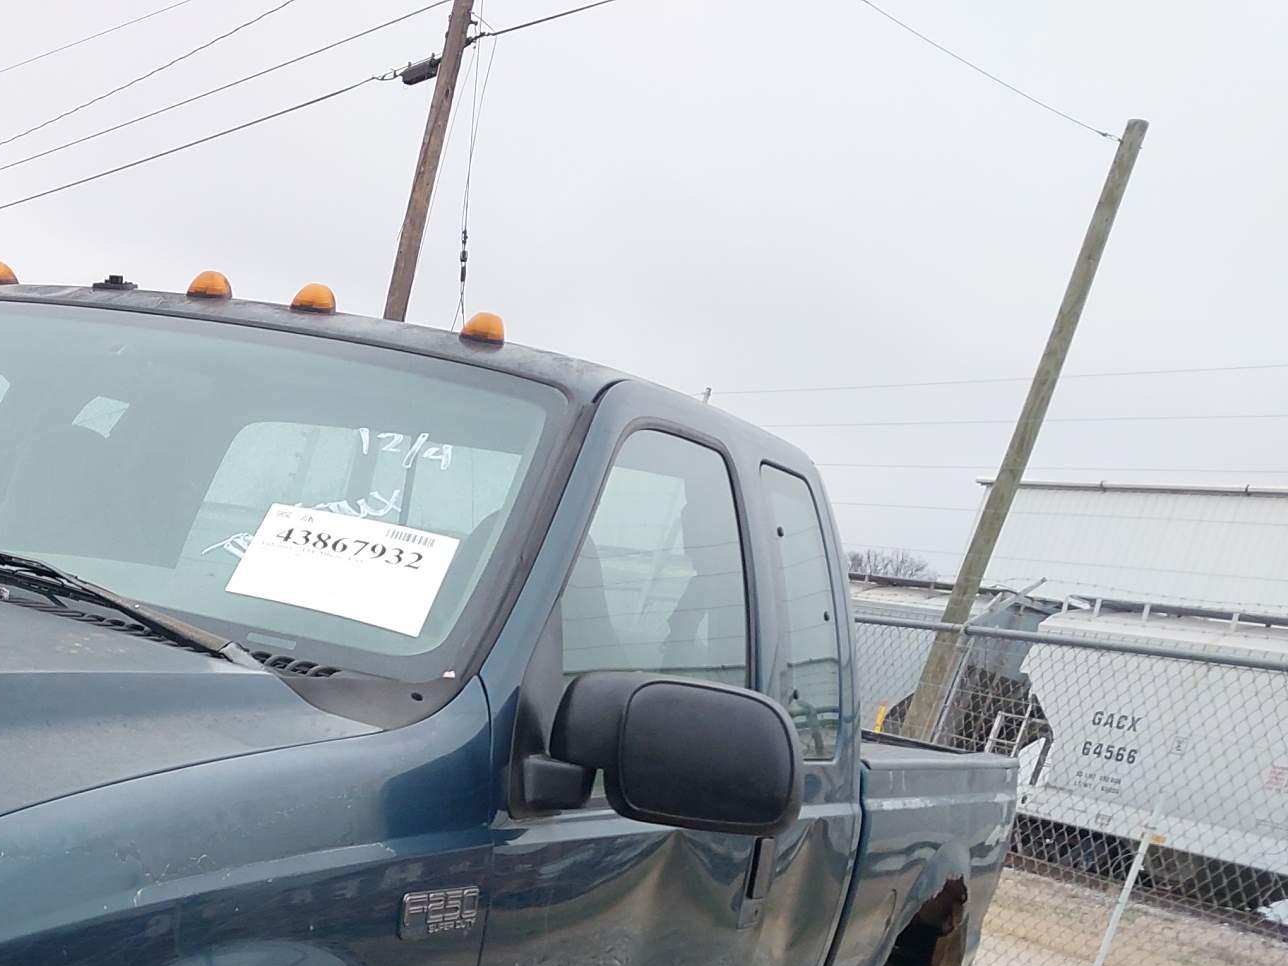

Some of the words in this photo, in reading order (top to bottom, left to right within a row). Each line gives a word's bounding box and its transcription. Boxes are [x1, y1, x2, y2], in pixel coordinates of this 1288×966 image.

[276, 527, 424, 570] 43867932
[1092, 710, 1143, 732] GACX
[1081, 740, 1138, 764] 64566
